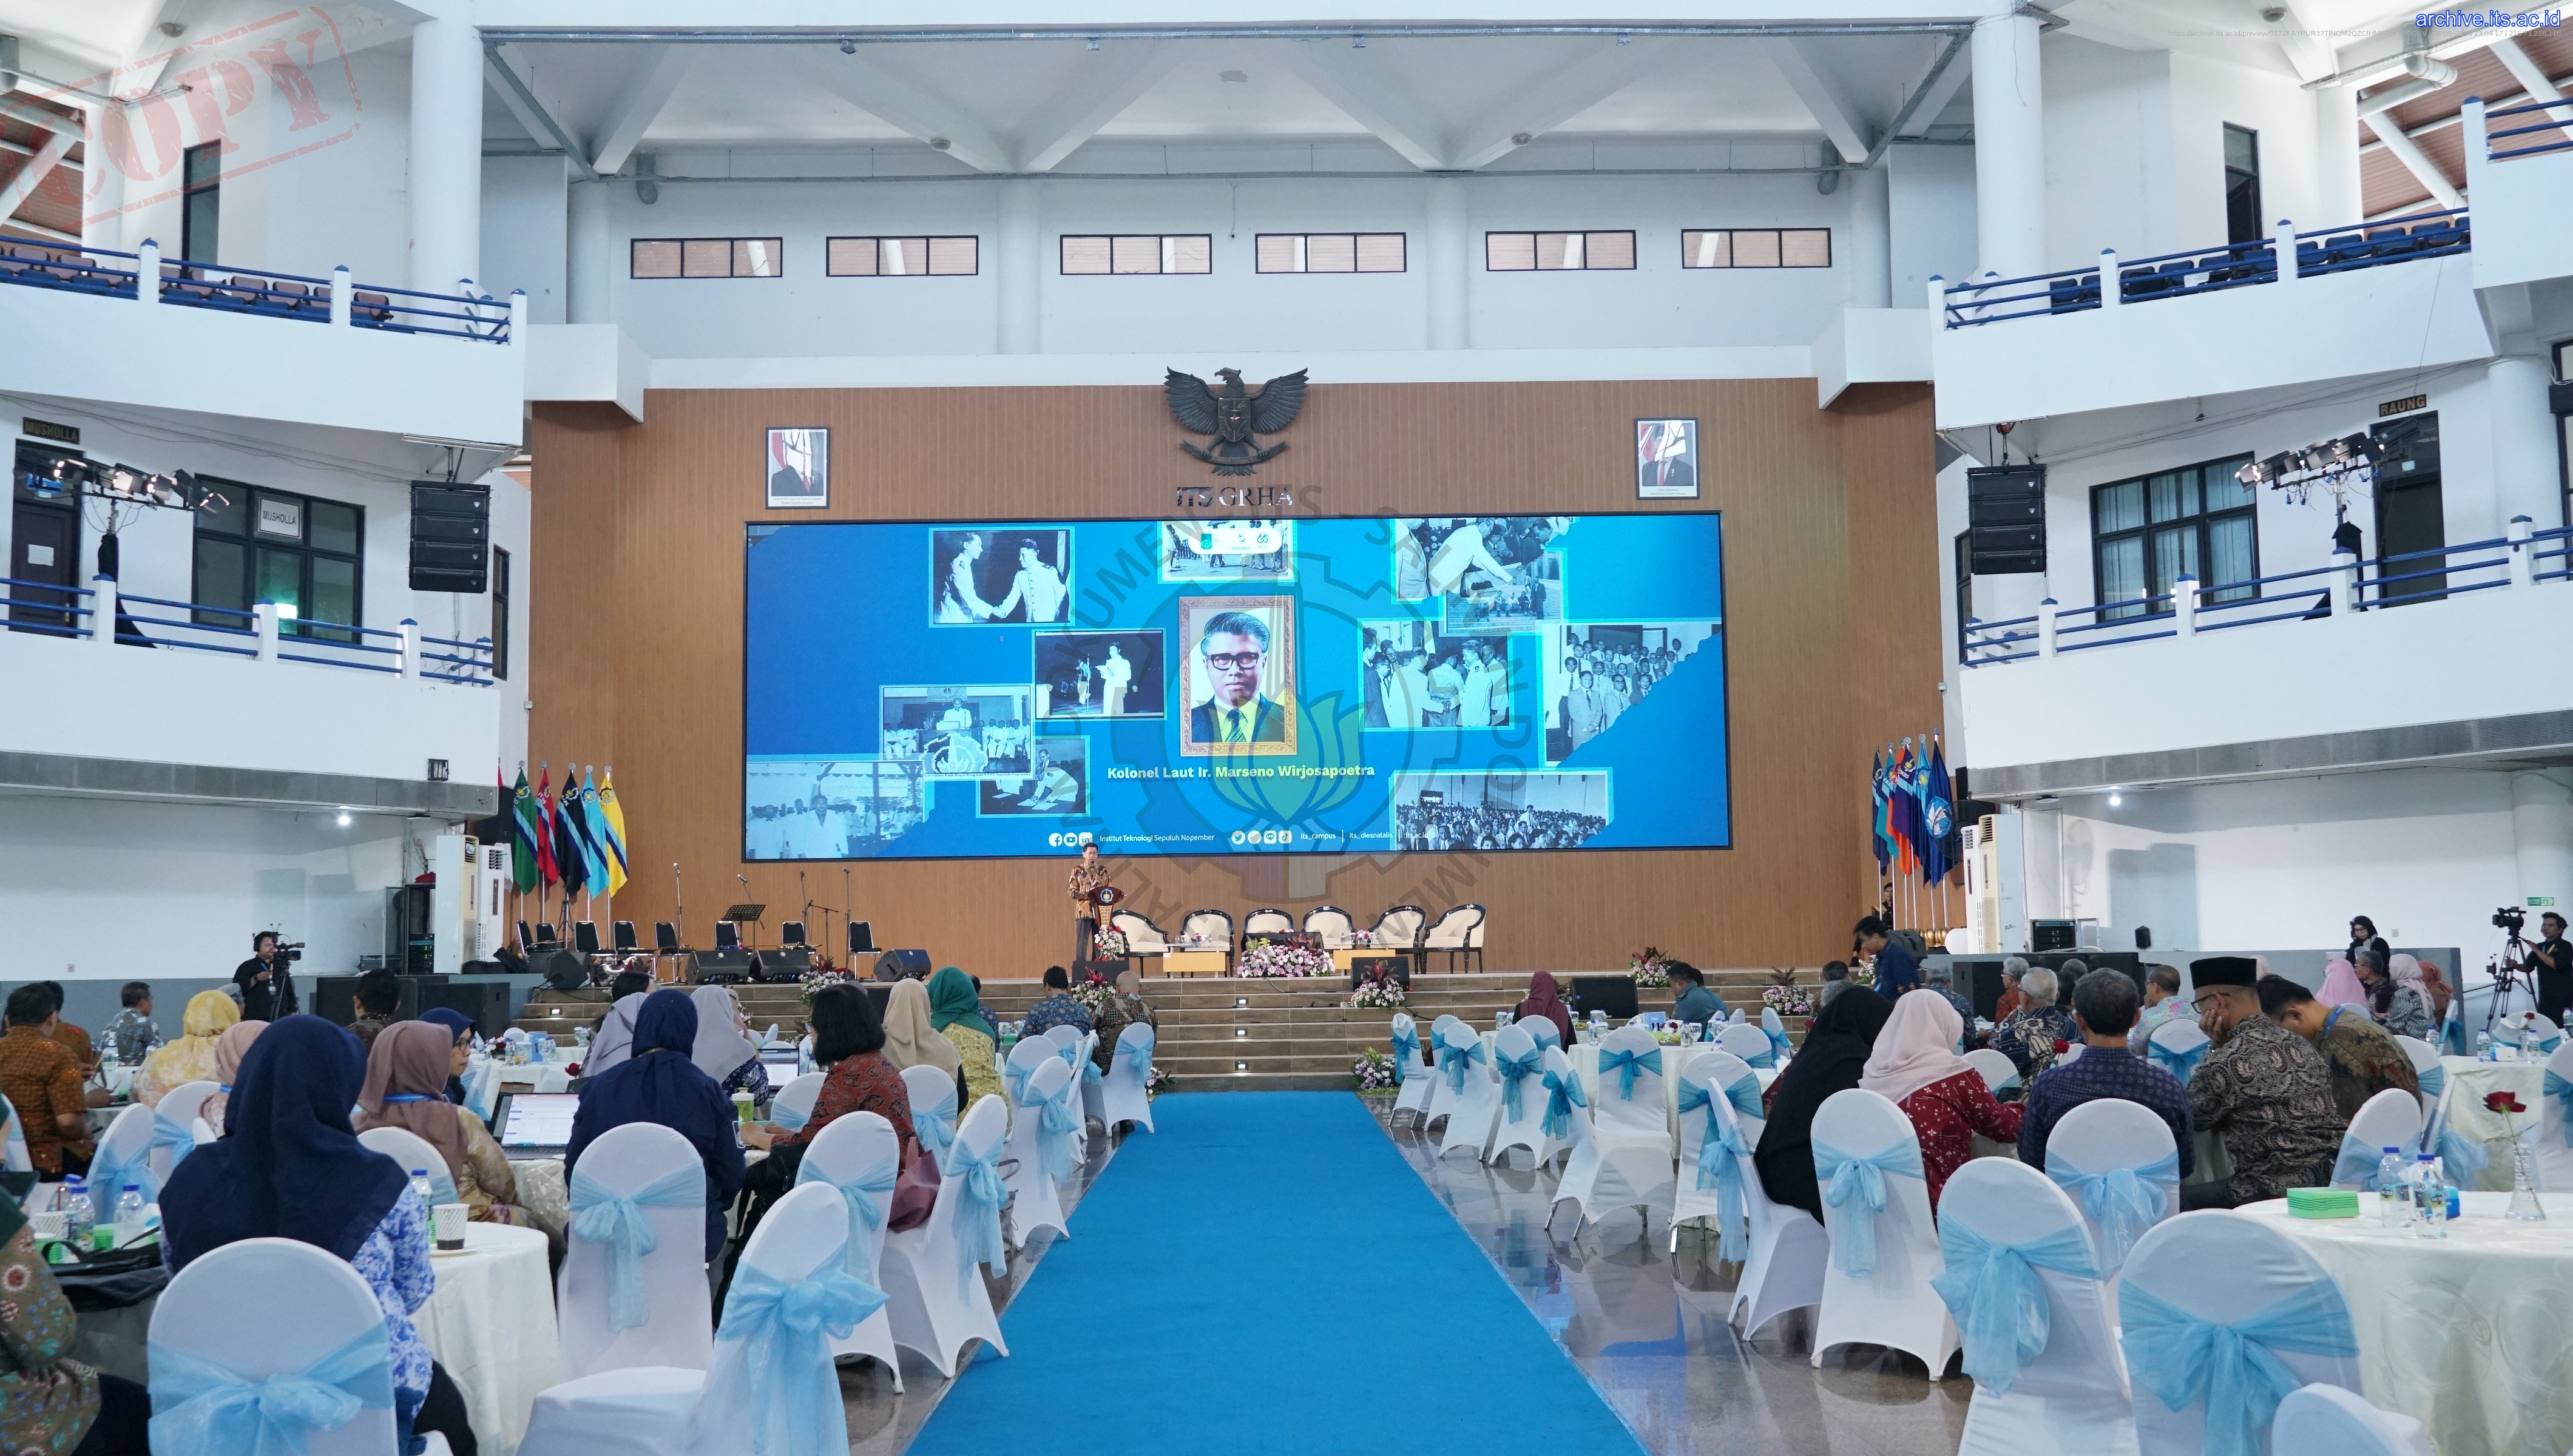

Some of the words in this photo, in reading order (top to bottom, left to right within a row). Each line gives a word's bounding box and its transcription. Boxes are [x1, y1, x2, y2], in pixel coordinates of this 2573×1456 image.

[2380, 396, 2425, 416] RAUNG
[24, 419, 78, 442] MUSHOLLA
[1219, 487, 1294, 507] GRHA
[263, 510, 297, 525] MUSHOLLA
[1107, 766, 1160, 779] Kolonel
[1163, 766, 1194, 778] Laut
[1198, 766, 1211, 778] Ir.
[1215, 766, 1275, 778] Marseno
[1277, 764, 1375, 779] Wirjosapoetra
[1123, 834, 1153, 843] Teknologi
[1154, 834, 1180, 843] Sepuluh
[1181, 834, 1214, 843] Nopember
